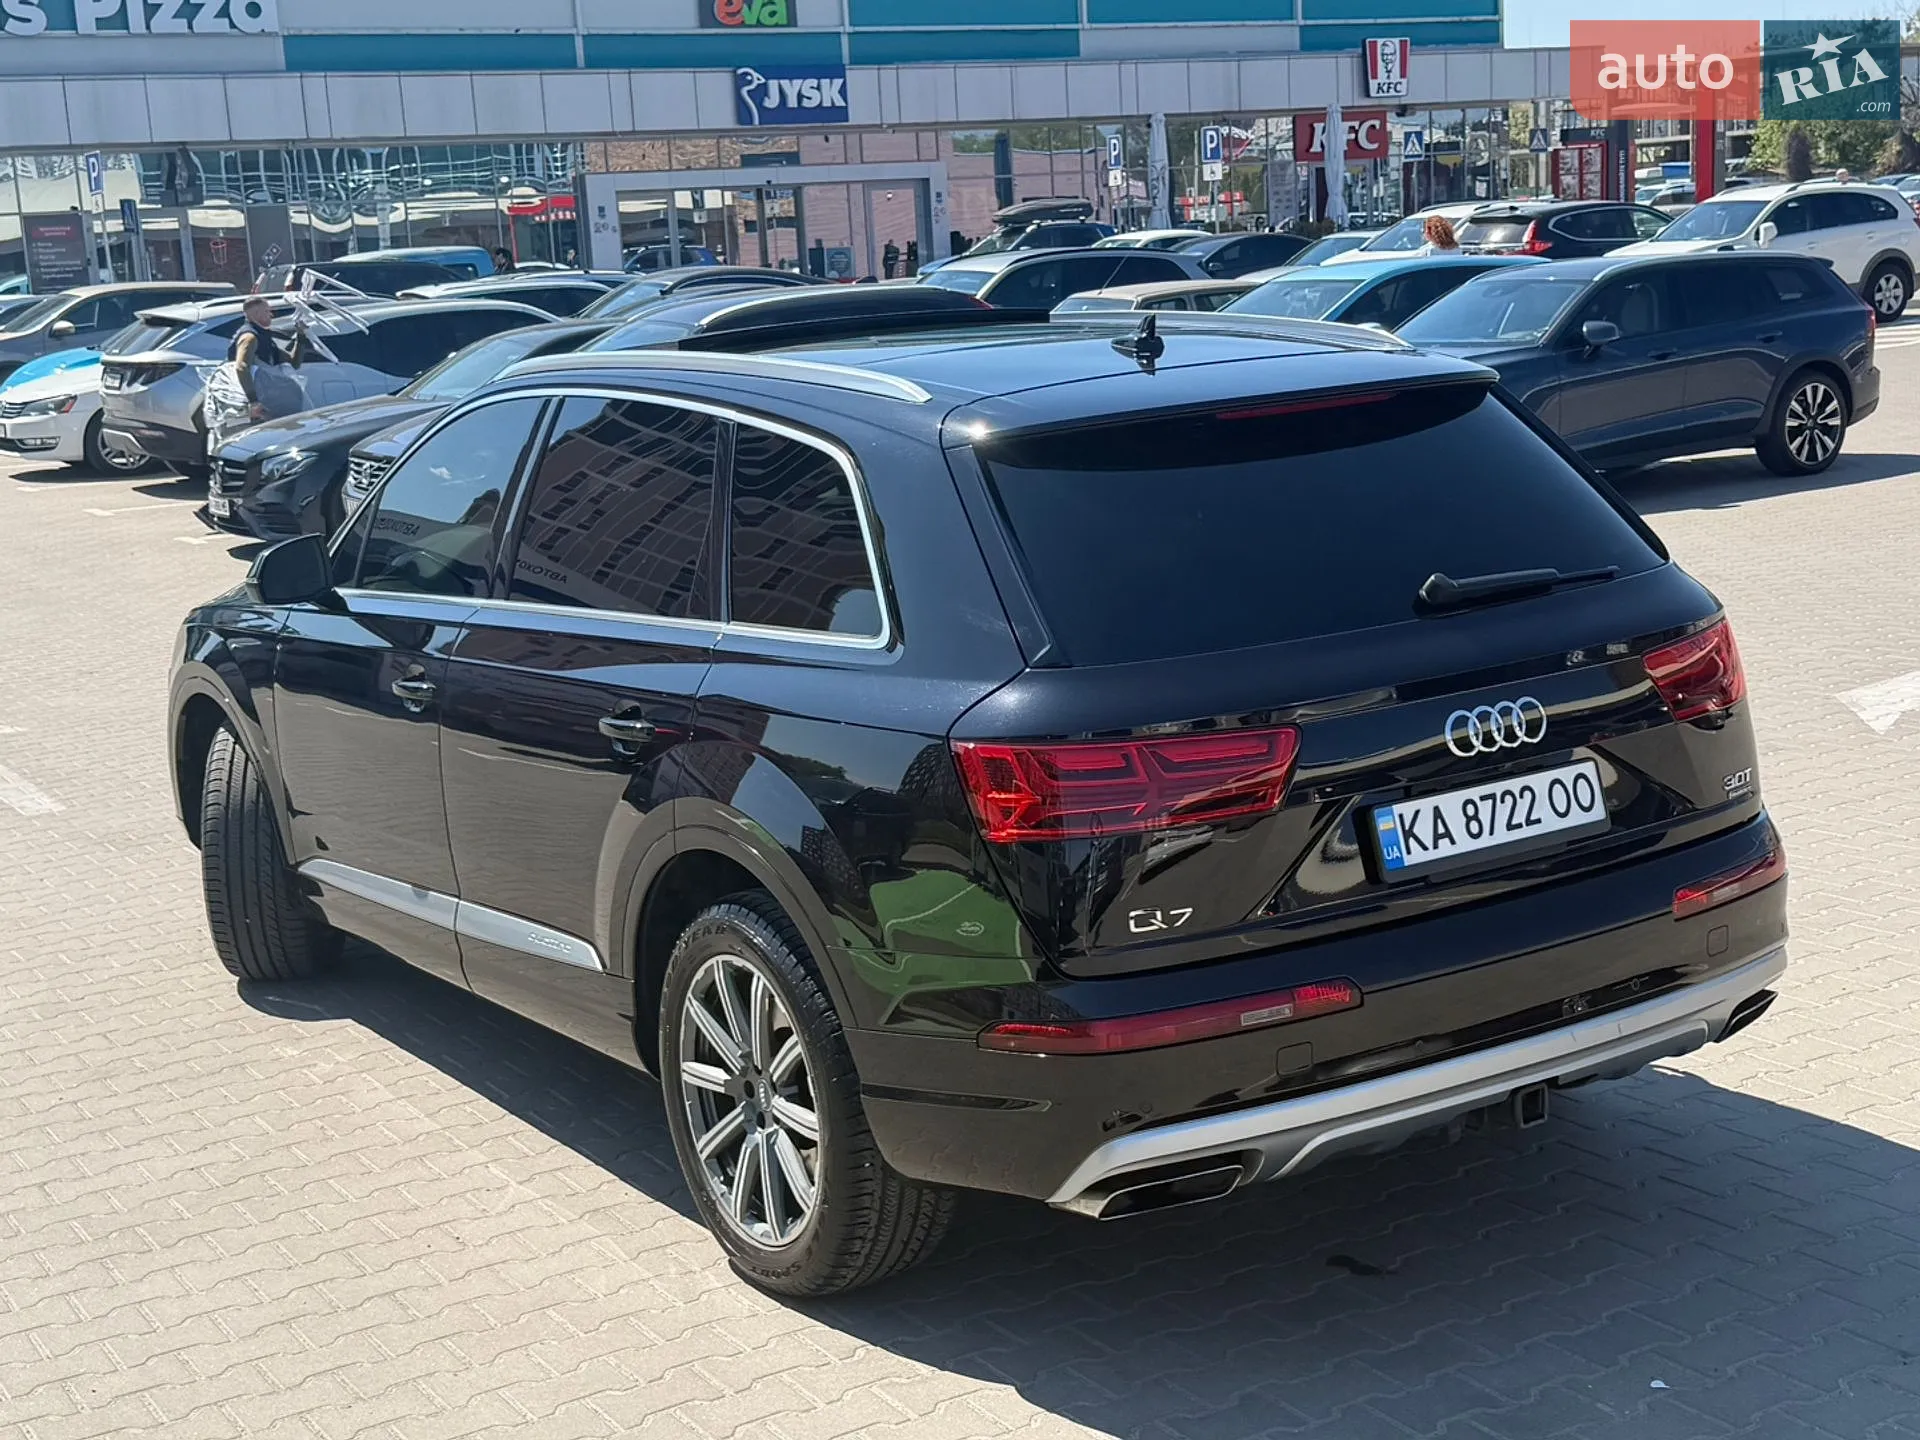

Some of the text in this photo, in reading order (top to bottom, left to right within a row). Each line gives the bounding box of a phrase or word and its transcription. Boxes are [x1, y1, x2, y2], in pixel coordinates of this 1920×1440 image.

[75, 0, 280, 35] Pizza
[714, 0, 788, 26] eva
[763, 78, 848, 109] JYSK
[1376, 82, 1403, 94] KFC
[1206, 130, 1218, 158] P
[1590, 128, 1606, 137] KFC
[1110, 139, 1120, 165] P
[88, 157, 99, 191] P
[1399, 805, 1457, 855] KA
[1462, 784, 1543, 840] 8722
[1383, 846, 1402, 860] UA
[1129, 907, 1194, 933] Q7
